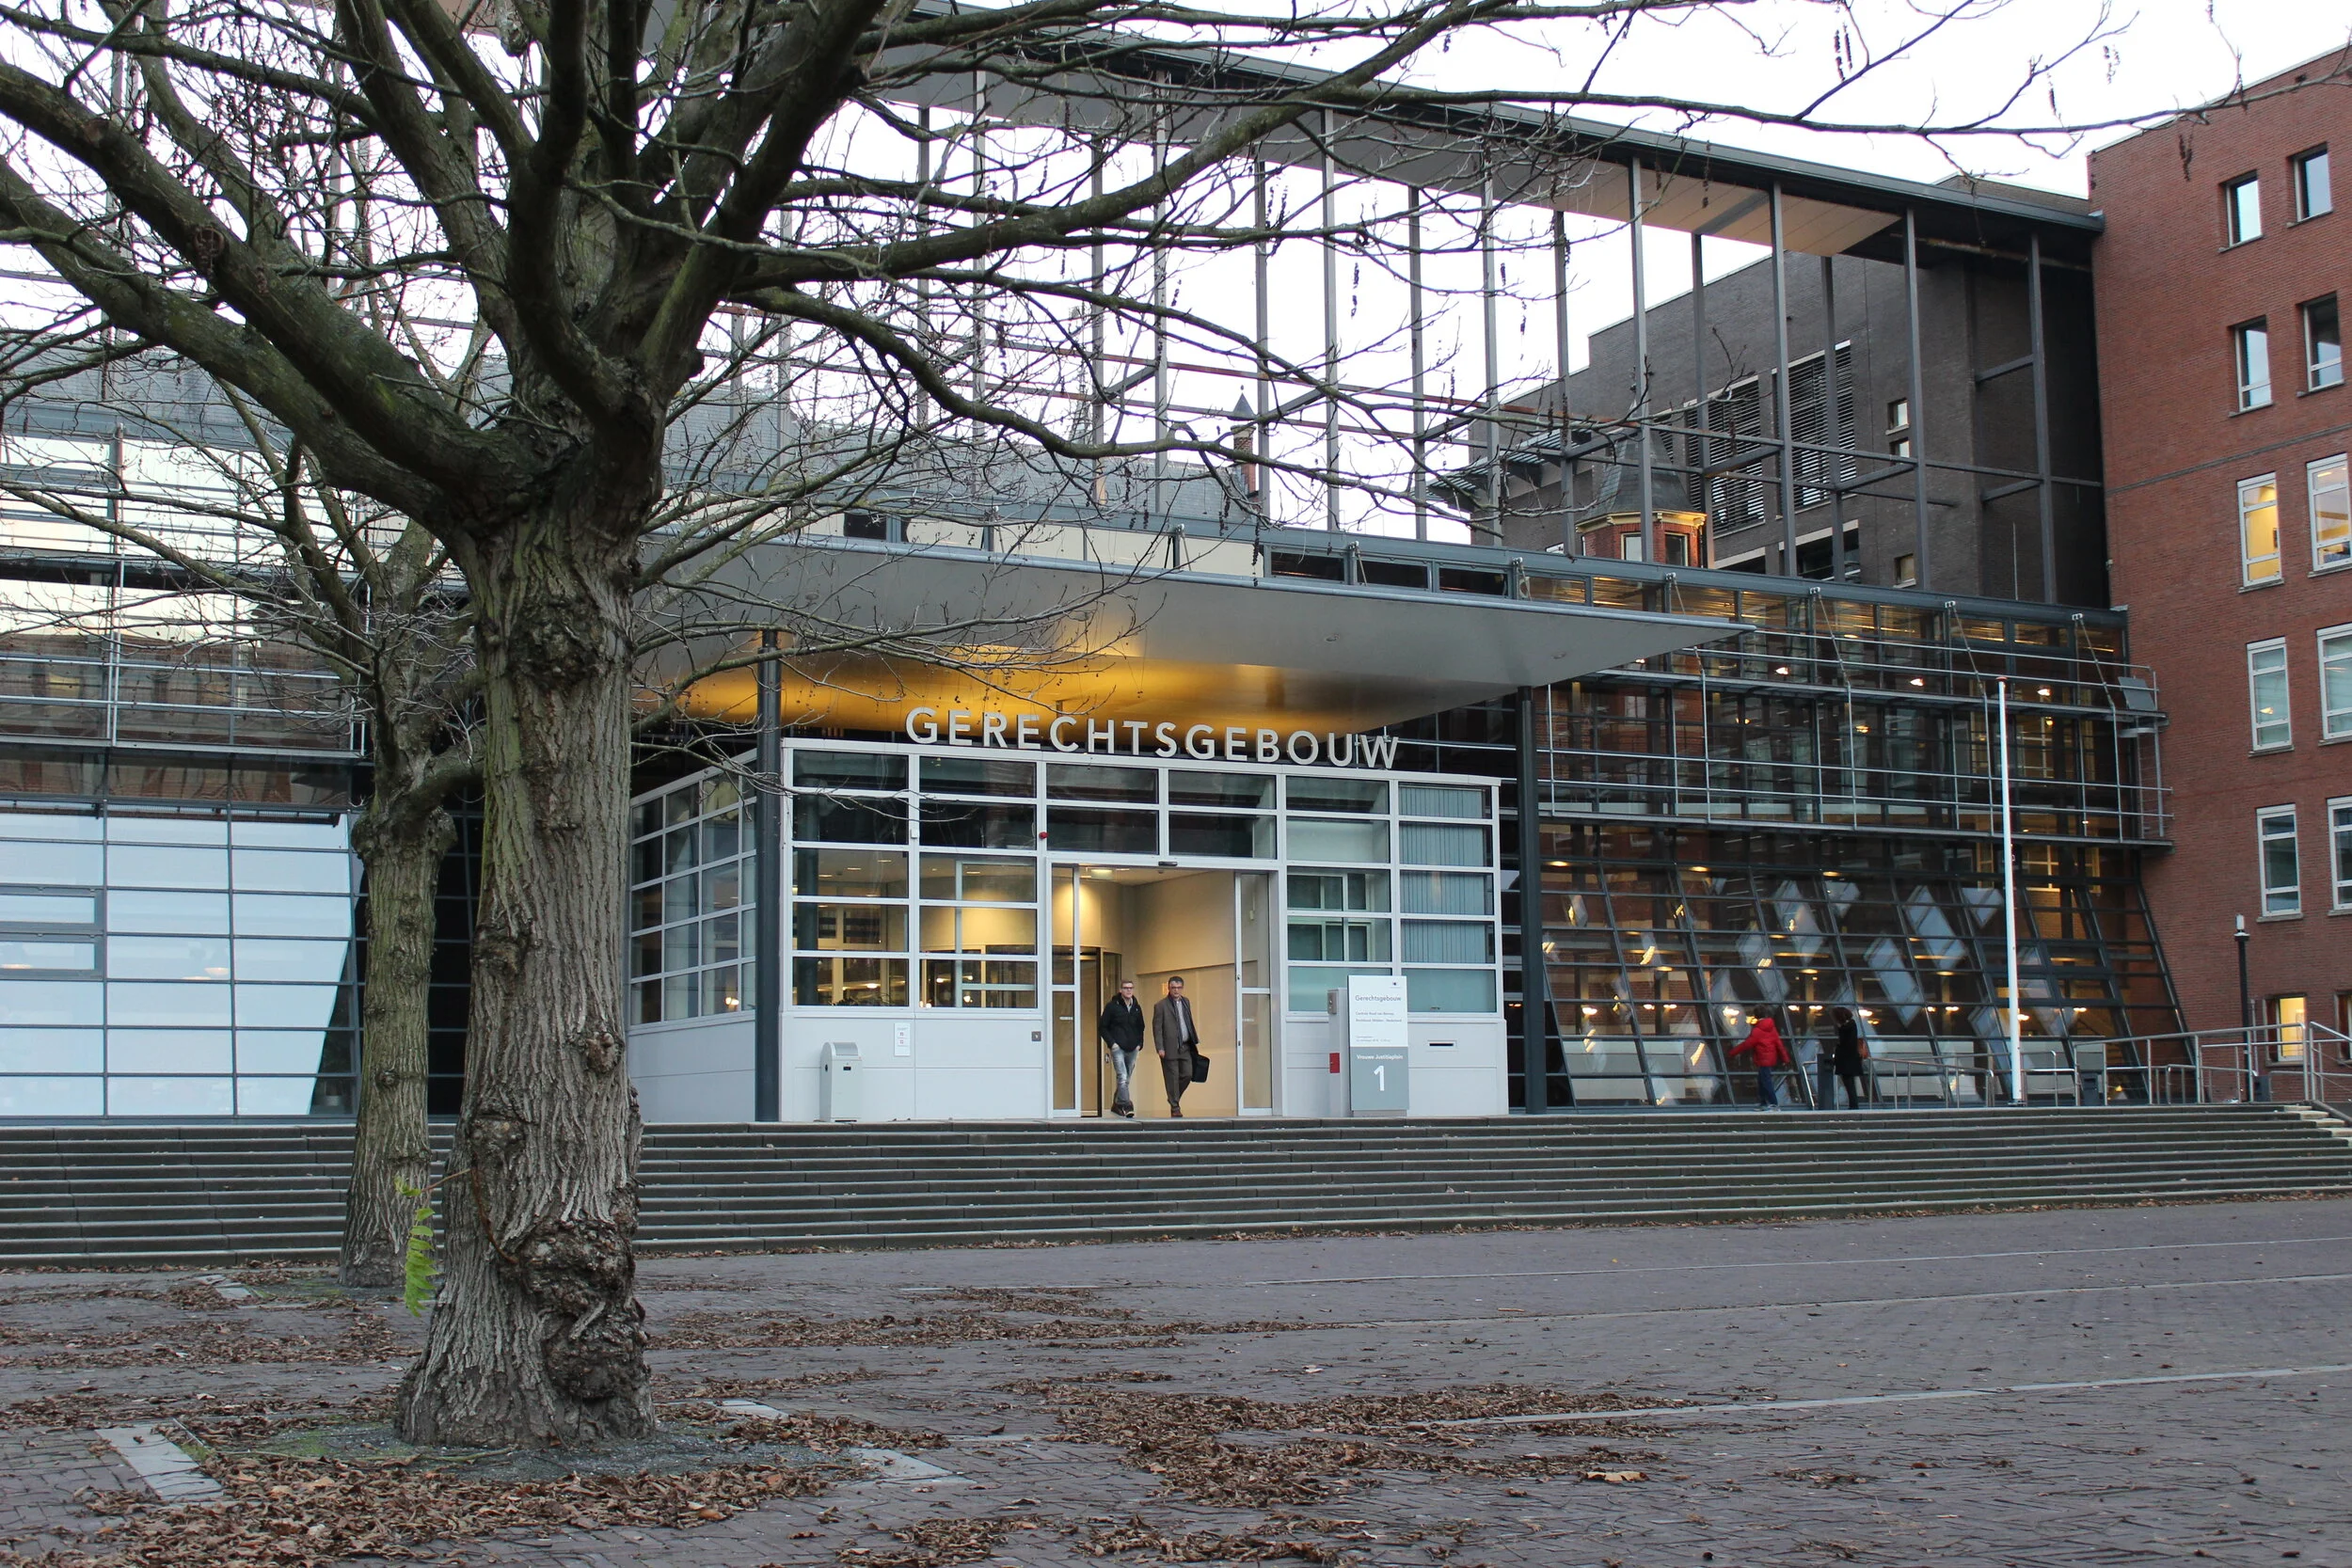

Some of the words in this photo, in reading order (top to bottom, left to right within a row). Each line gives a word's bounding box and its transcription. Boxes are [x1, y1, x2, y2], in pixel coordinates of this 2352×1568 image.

[905, 706, 1399, 769] GERECHTSGEBOUW
[1355, 994, 1401, 1003] Gerechtsgebouw
[1374, 1065, 1385, 1091] 1
